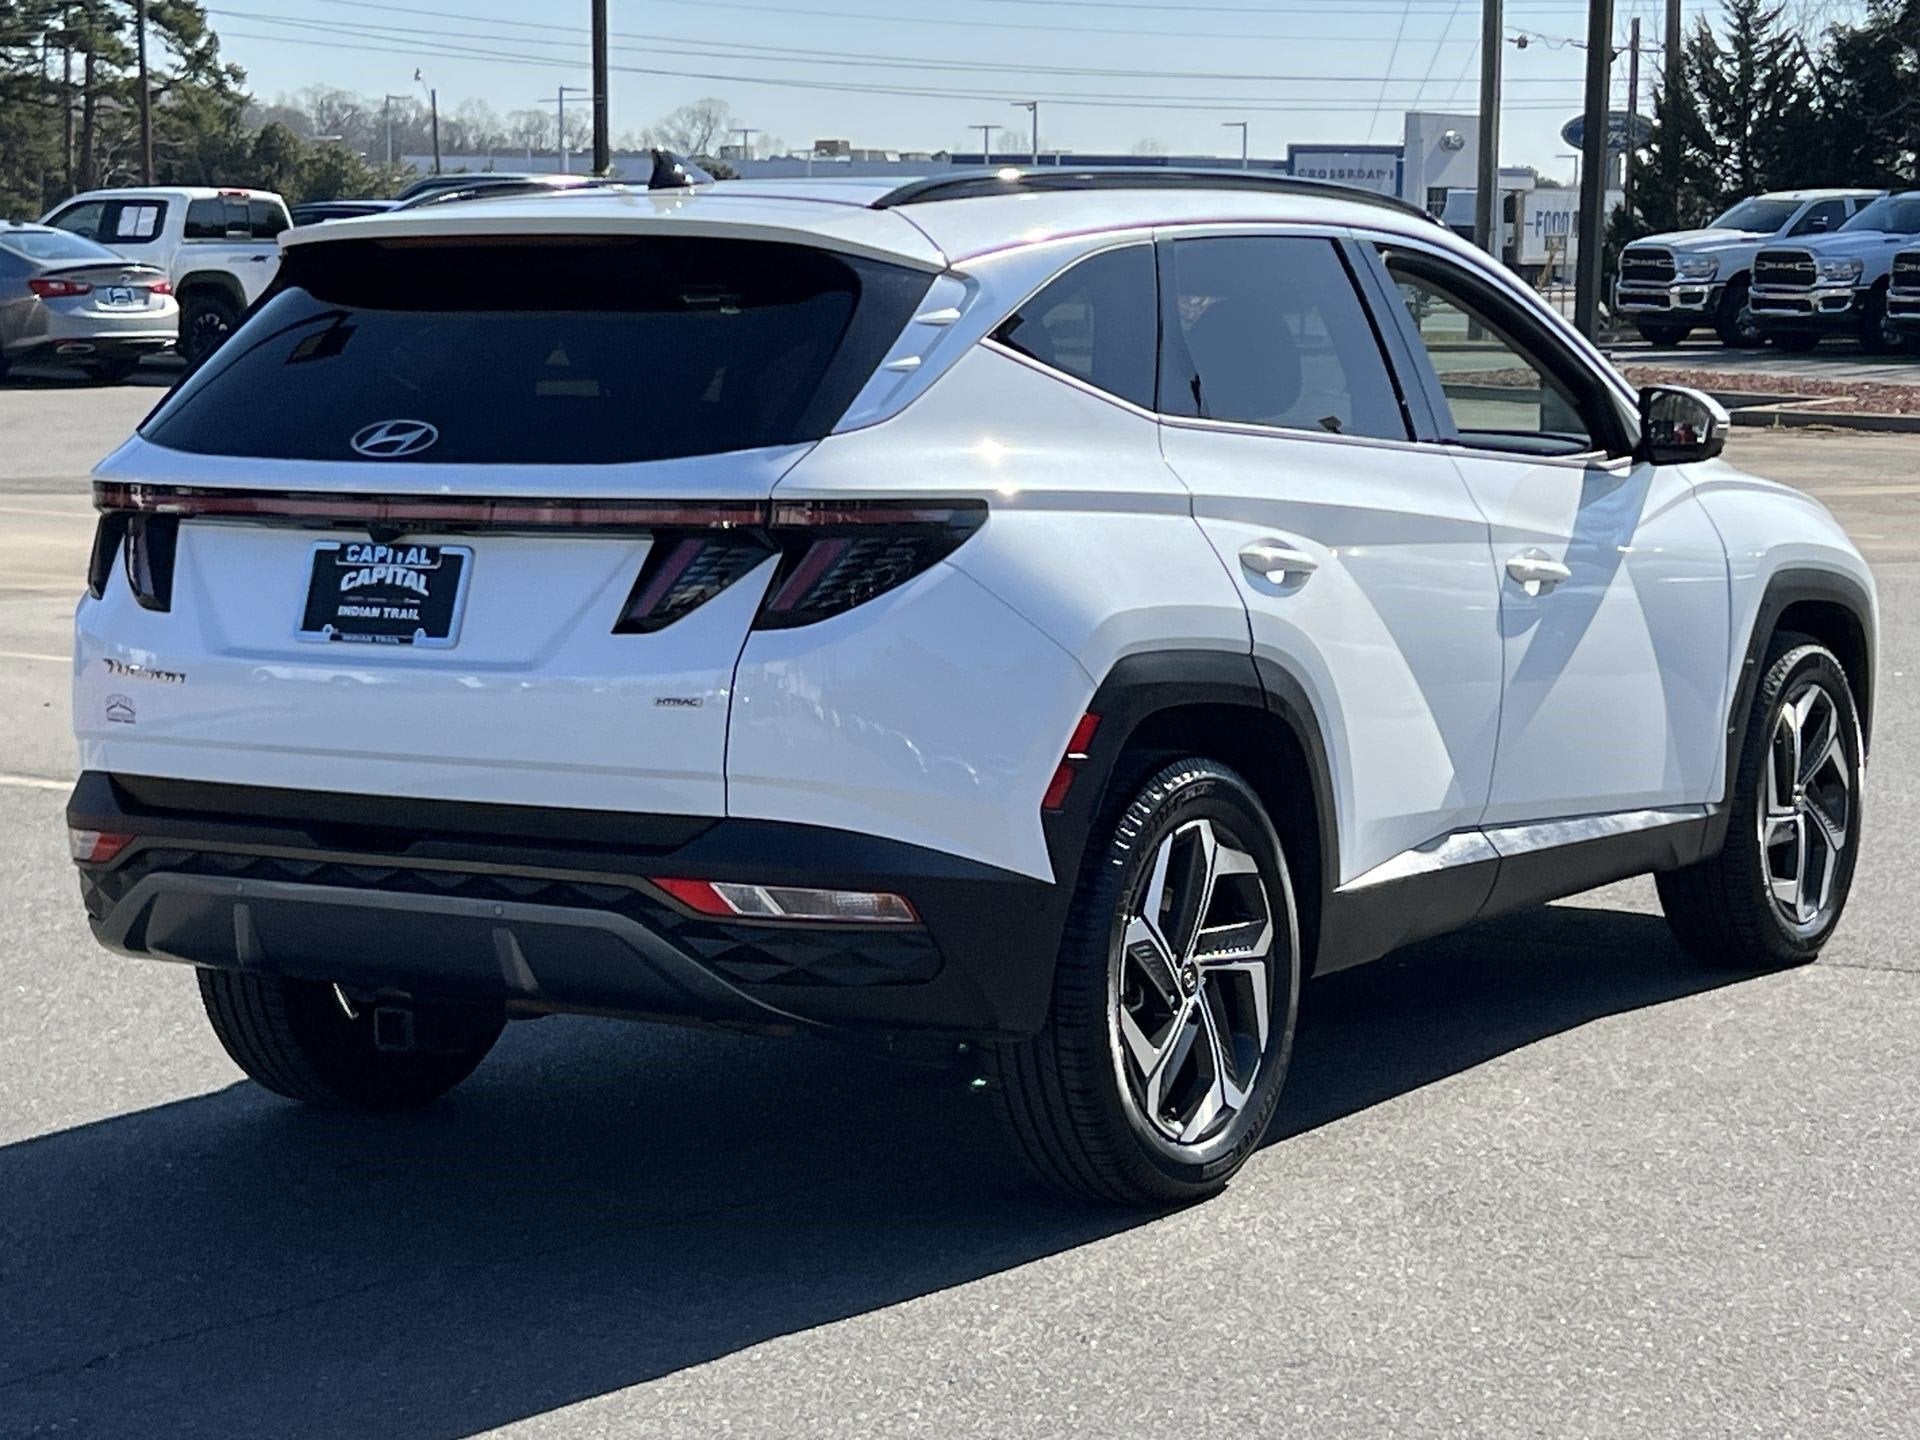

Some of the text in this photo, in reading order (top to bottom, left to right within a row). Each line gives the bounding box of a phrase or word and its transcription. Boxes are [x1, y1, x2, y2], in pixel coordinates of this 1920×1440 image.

[340, 566, 429, 597] CAPITAL
[337, 605, 420, 621] INDIAN TRAIL
[102, 657, 187, 684] TUON
